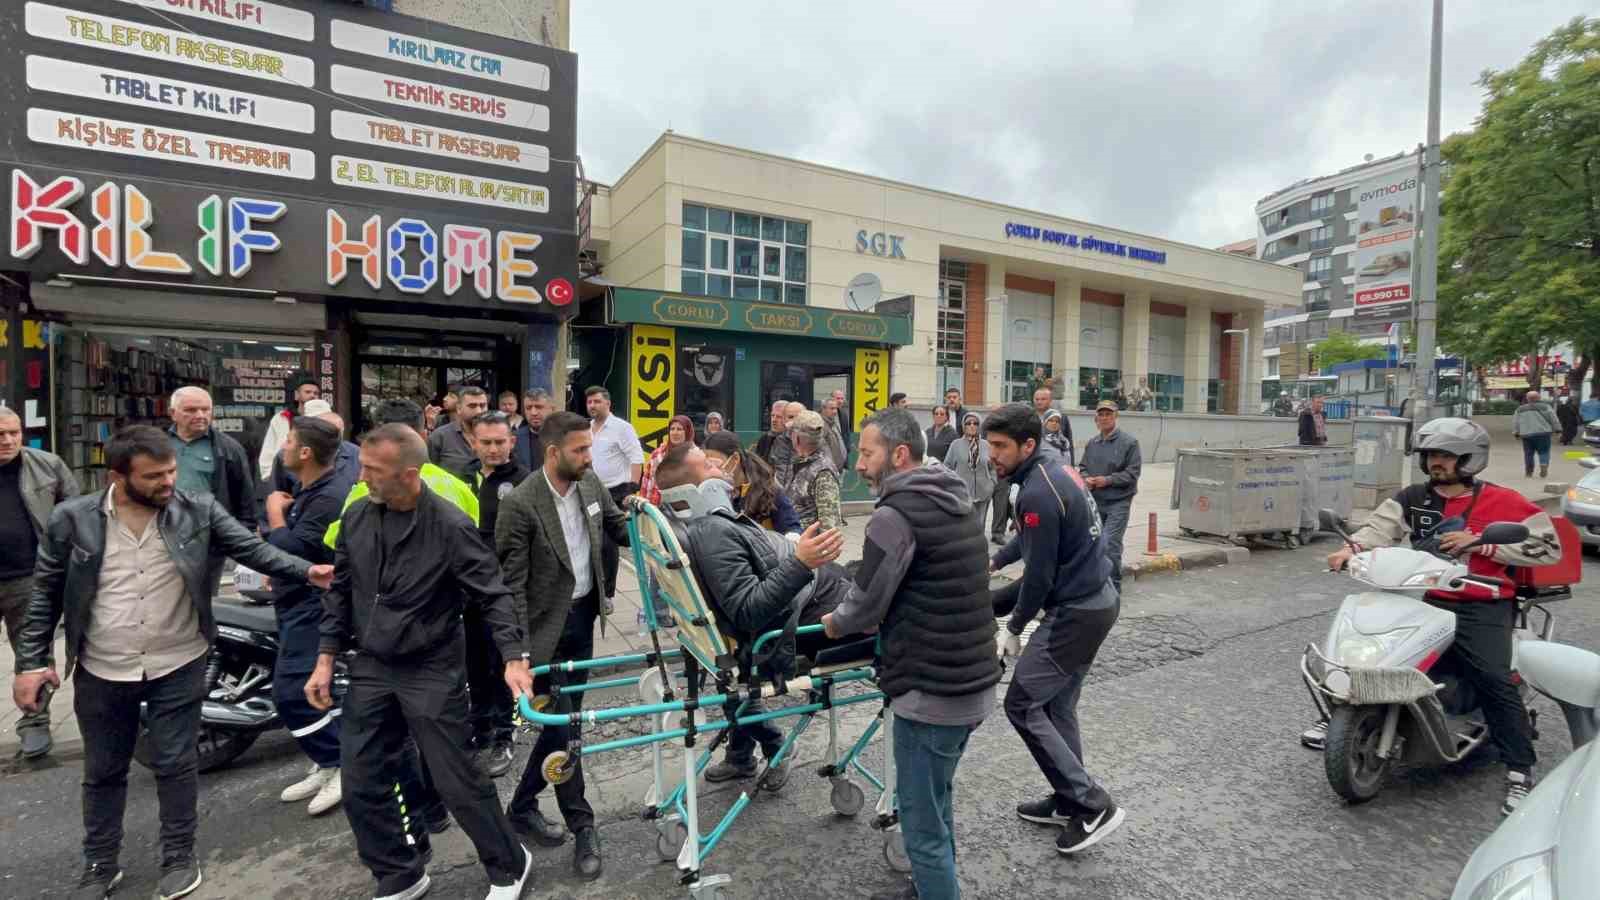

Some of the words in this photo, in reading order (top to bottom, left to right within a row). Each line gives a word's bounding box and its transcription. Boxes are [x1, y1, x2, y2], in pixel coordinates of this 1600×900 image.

[66, 16, 170, 54] TELEFON
[176, 37, 284, 76] AKSESUAR
[388, 36, 466, 72] KIRILMAZ
[470, 56, 502, 76] CAM
[100, 74, 187, 105] TABLET
[193, 89, 256, 118] KILIFI
[384, 79, 445, 107] TEKNİK
[450, 91, 506, 118] SERVİS
[57, 118, 135, 148] KİŞİYE
[142, 128, 198, 158] ÖZEL
[205, 140, 292, 171] TASARIM
[367, 120, 434, 148] TABLET
[438, 133, 520, 162] AKSESUAR
[357, 164, 378, 183] EL
[384, 167, 455, 192] TELEFON
[1360, 179, 1416, 202] evmoda
[10, 168, 287, 278] KILIF
[327, 208, 543, 303] HOME
[855, 229, 906, 259] SGK
